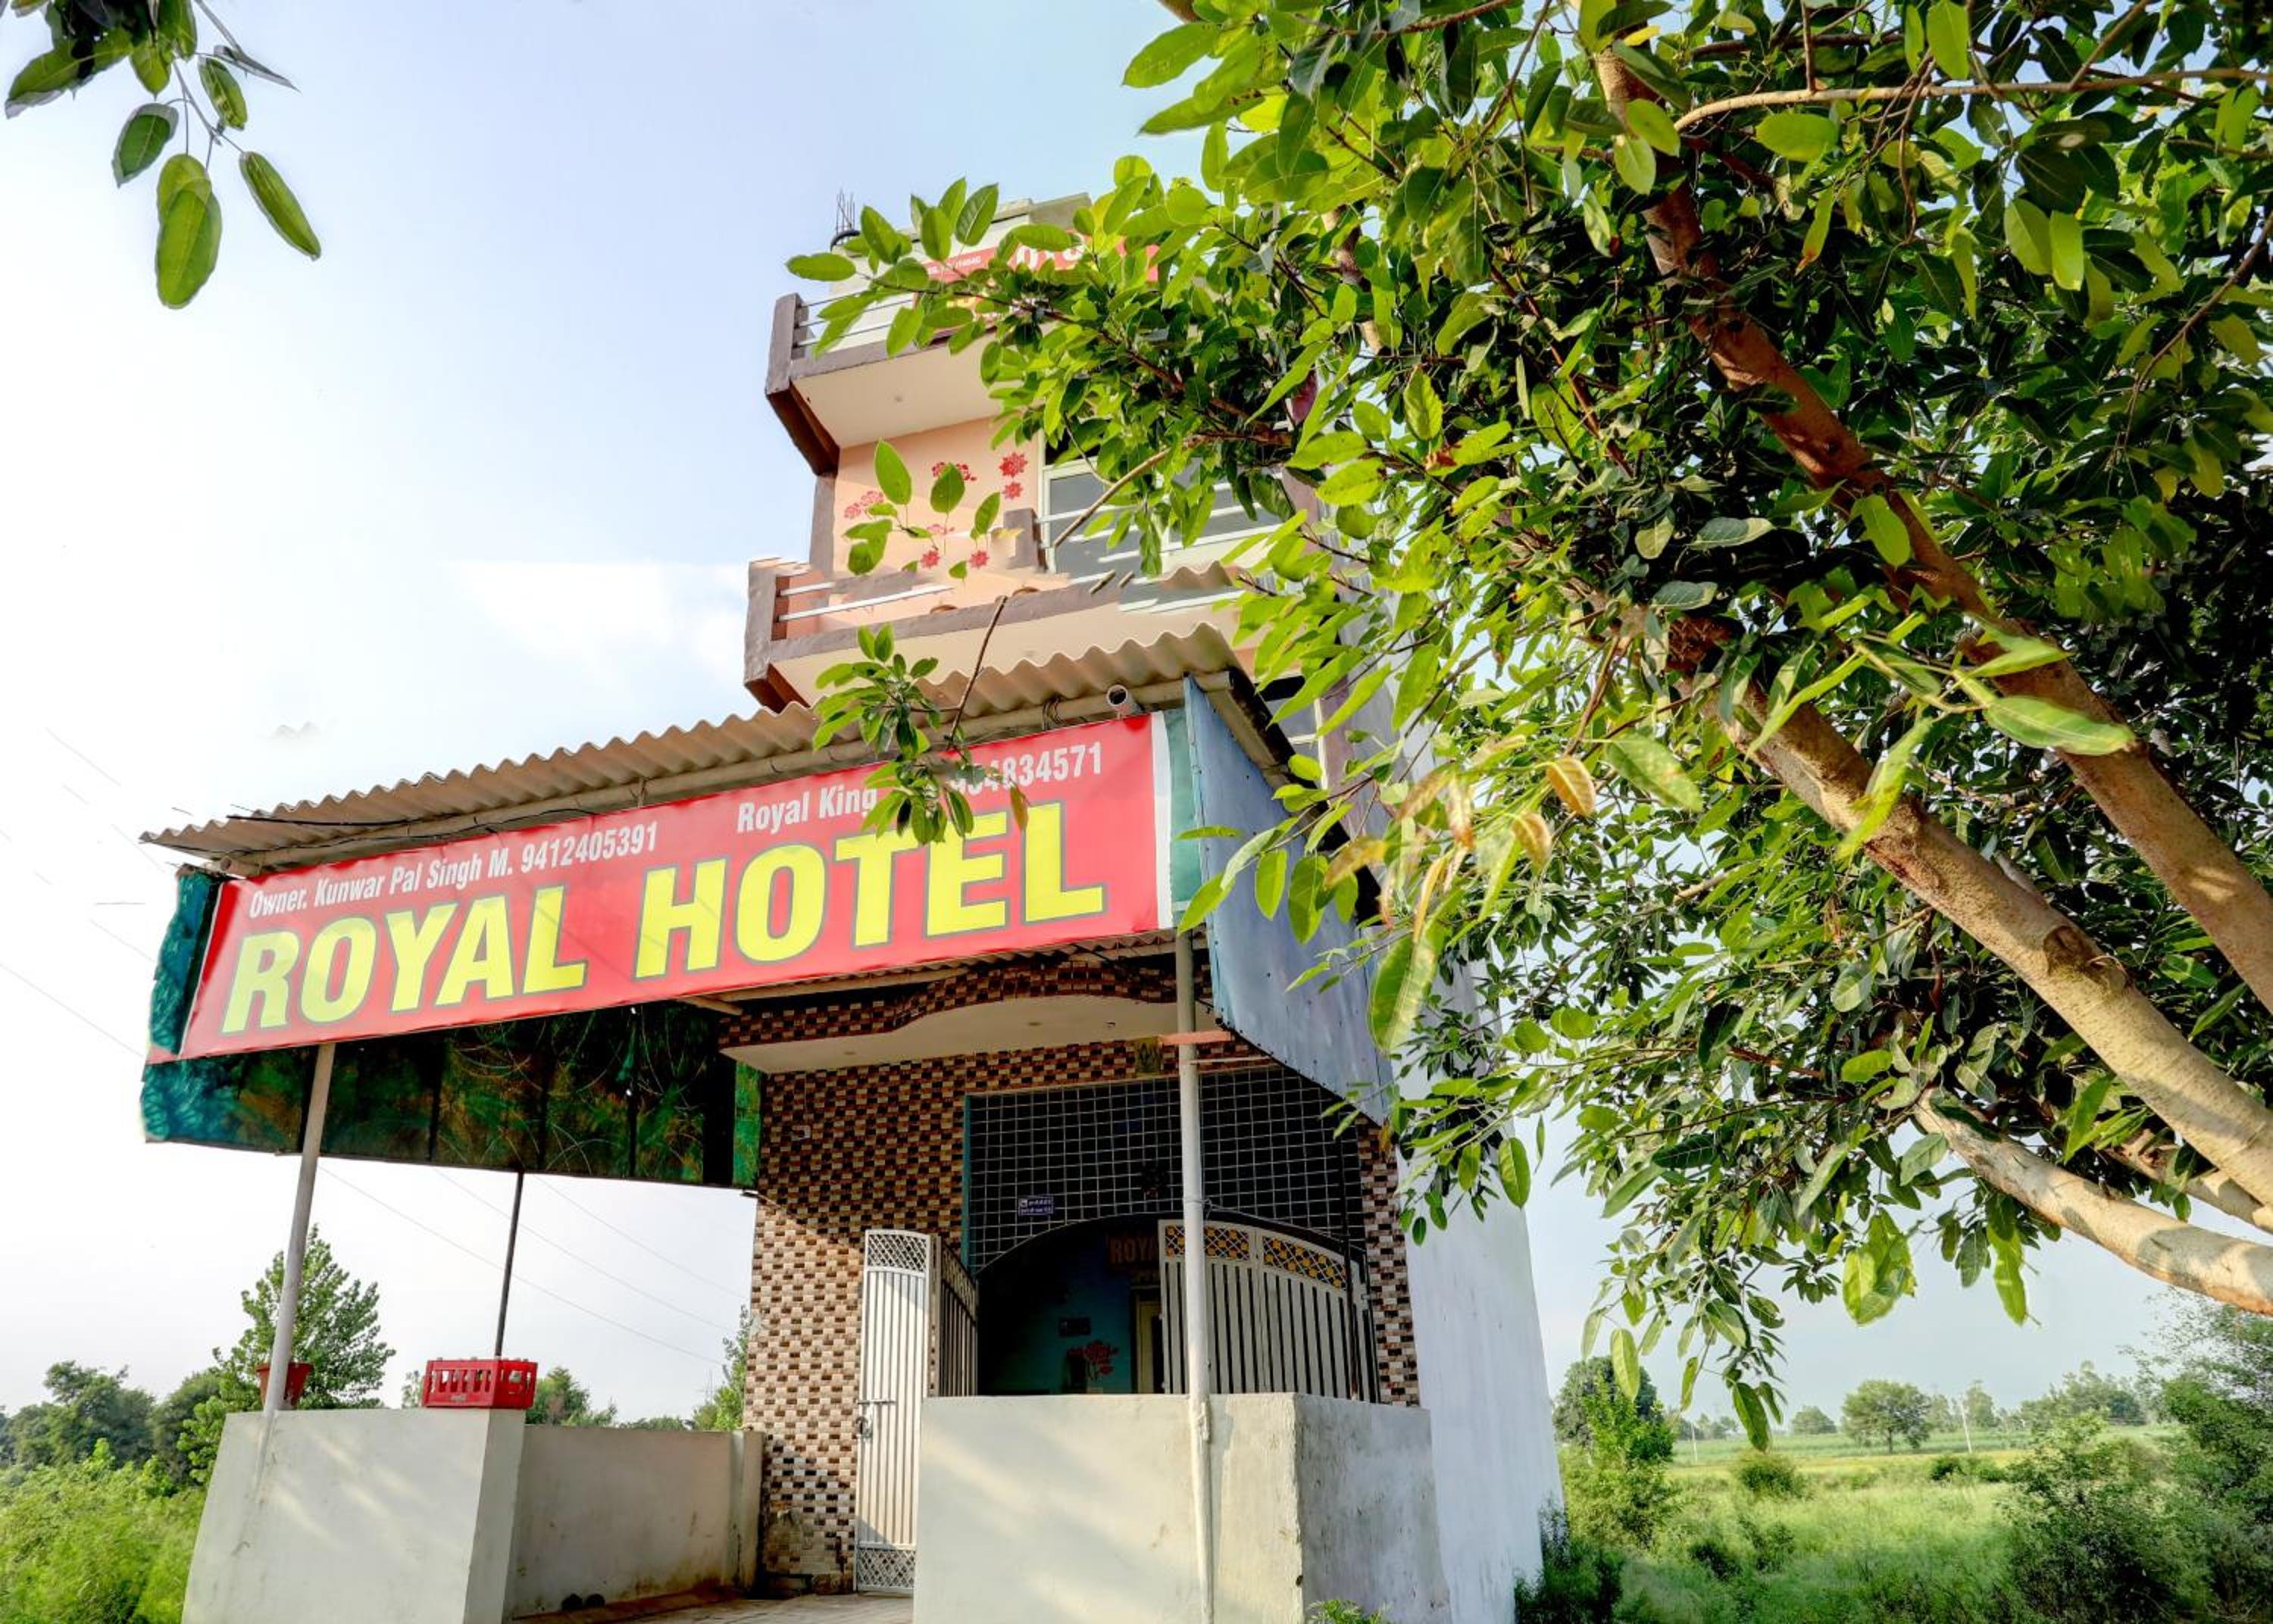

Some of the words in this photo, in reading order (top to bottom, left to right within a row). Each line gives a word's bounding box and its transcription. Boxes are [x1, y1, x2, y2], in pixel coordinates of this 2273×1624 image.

[737, 792, 811, 834] Royal
[219, 884, 589, 1035] ROYAL
[633, 799, 1106, 980] HOTEL
[249, 889, 307, 918] Owner.
[314, 874, 385, 907] Kunwar
[389, 862, 423, 895] Pal
[427, 853, 482, 890] Singh
[487, 848, 514, 878] M.
[521, 820, 658, 873] 9412405391
